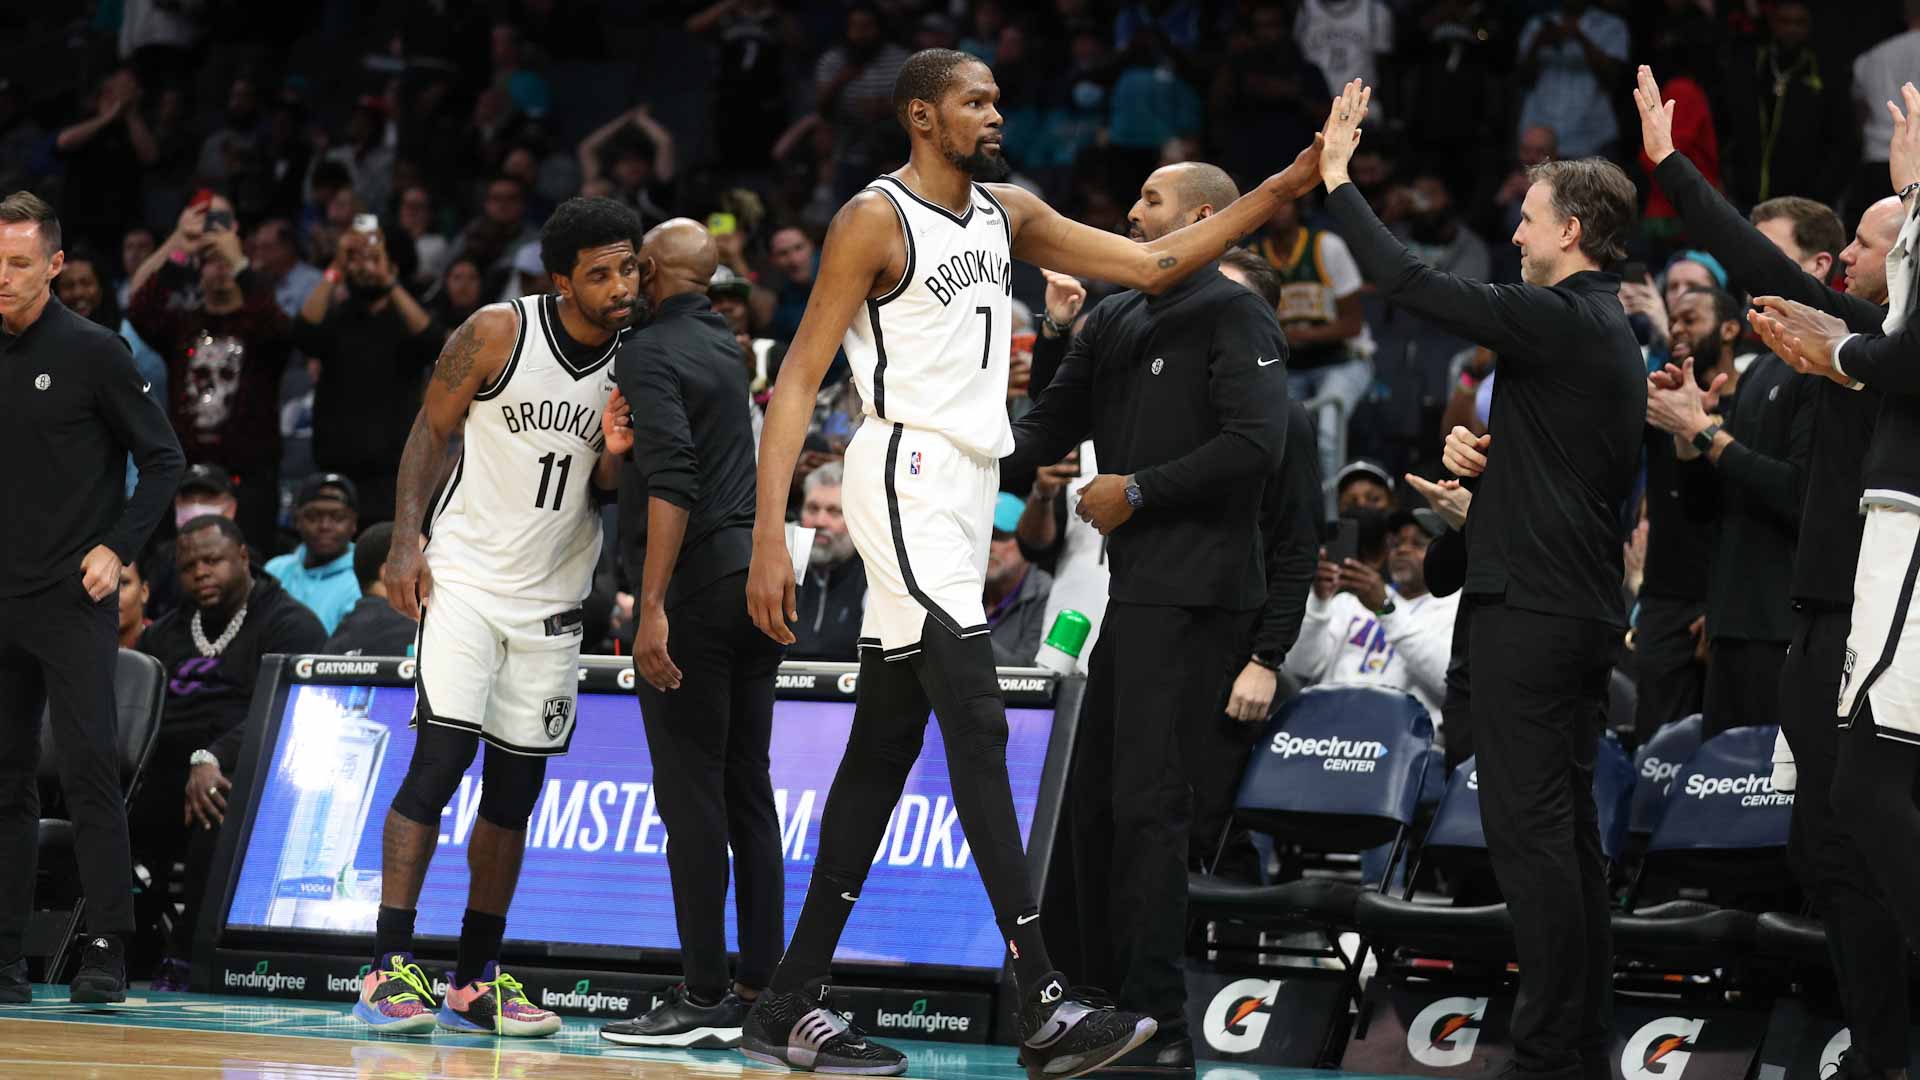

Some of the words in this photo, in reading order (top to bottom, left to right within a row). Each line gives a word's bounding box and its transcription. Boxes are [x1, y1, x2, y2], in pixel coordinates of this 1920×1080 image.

[925, 250, 1011, 307] BROOKLYN
[976, 306, 991, 370] 7
[502, 400, 605, 453] BROOKLY
[535, 452, 573, 511] 11
[296, 658, 314, 679] G
[316, 661, 378, 675] GATORADE
[398, 660, 415, 679] G
[617, 667, 635, 690] G
[837, 672, 858, 694] G
[1271, 731, 1382, 759] Spectrum
[1323, 758, 1375, 773] CENTER
[1685, 773, 1775, 799] Spectru
[1741, 794, 1795, 807] CENTER
[301, 882, 332, 893] VODKA
[225, 969, 306, 992] lendingtree
[542, 987, 629, 1012] lendingtree
[877, 1008, 970, 1032] lendingtree
[1202, 977, 1281, 1054] G
[1406, 996, 1488, 1067] G
[1620, 1016, 1705, 1080] G
